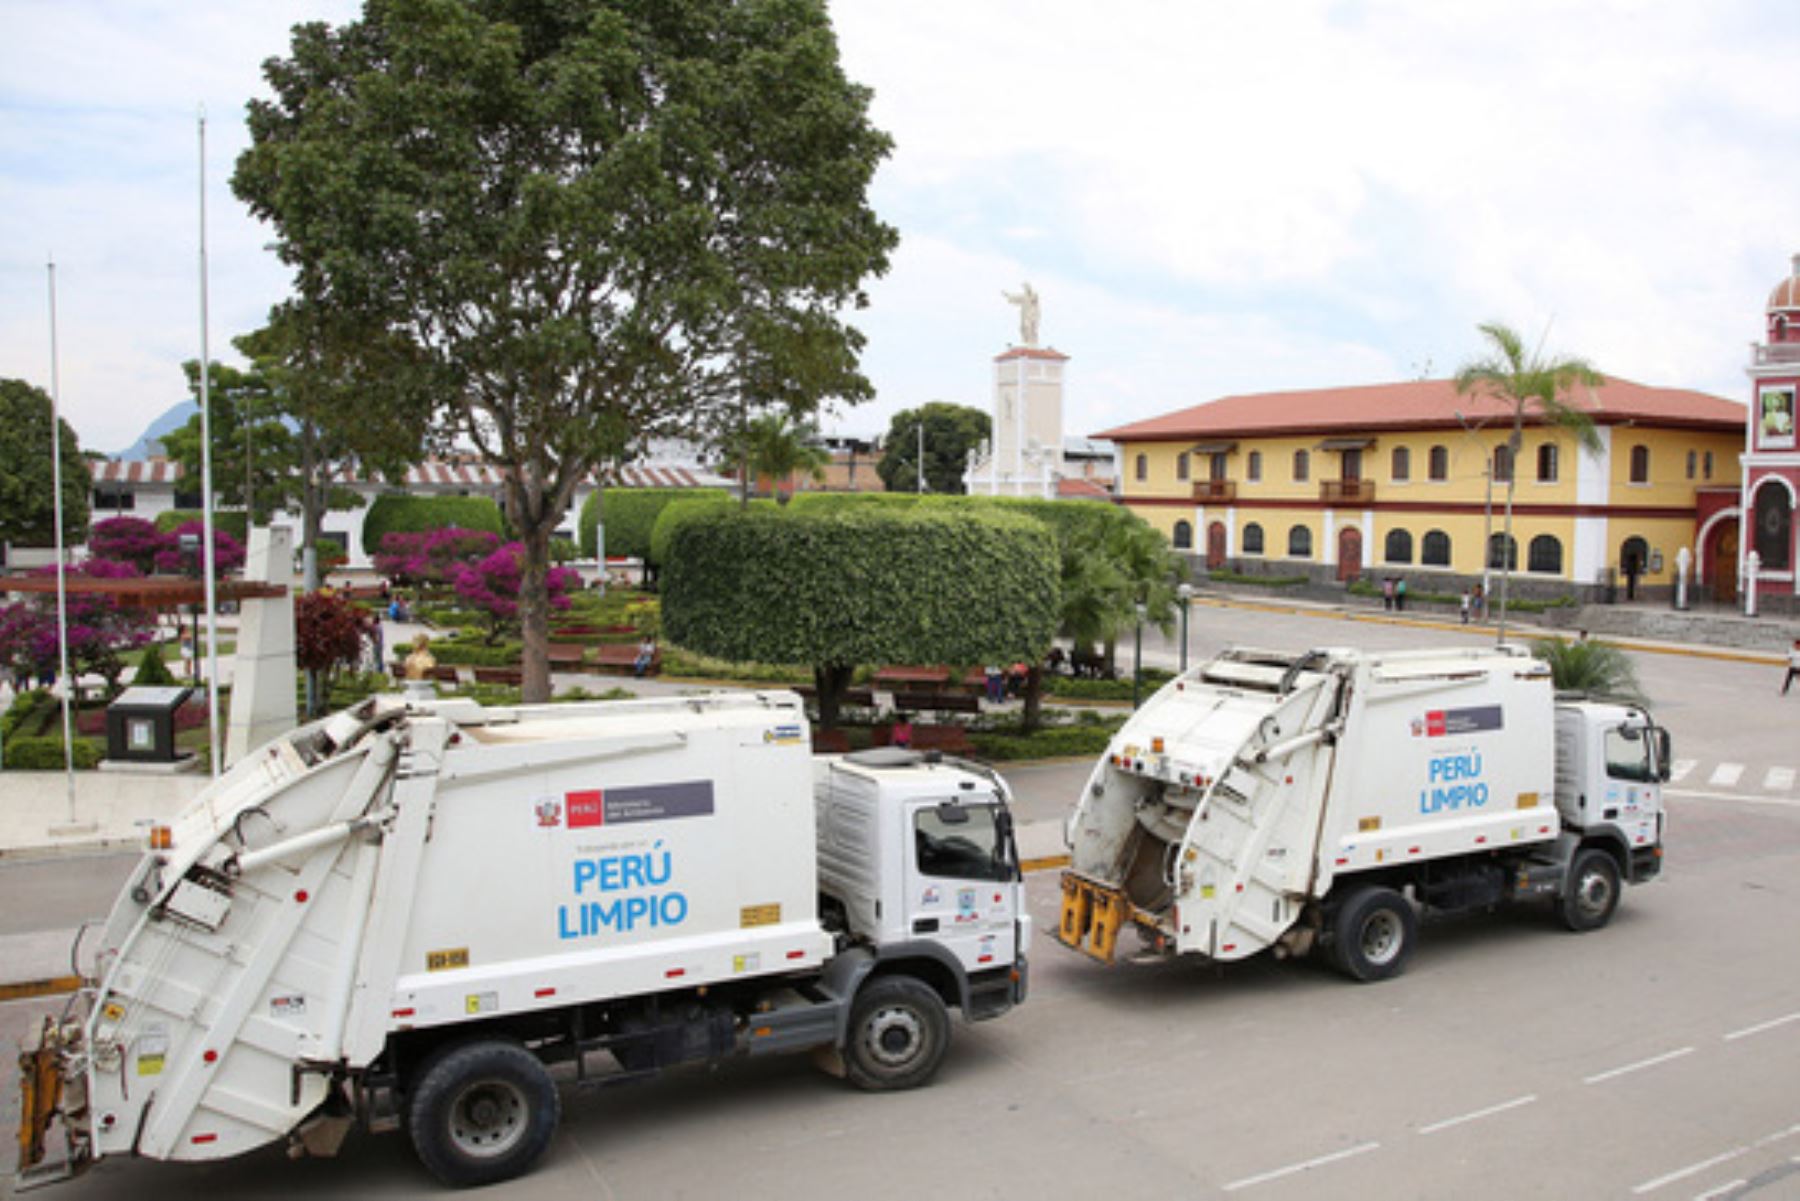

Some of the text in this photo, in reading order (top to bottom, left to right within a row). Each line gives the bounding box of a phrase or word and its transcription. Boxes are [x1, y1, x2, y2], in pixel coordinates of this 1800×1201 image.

[1429, 745, 1482, 783] PERÚ
[1420, 782, 1489, 815] LIMPIO
[572, 838, 672, 895] PERÚ
[558, 891, 689, 940] LIMPIO
